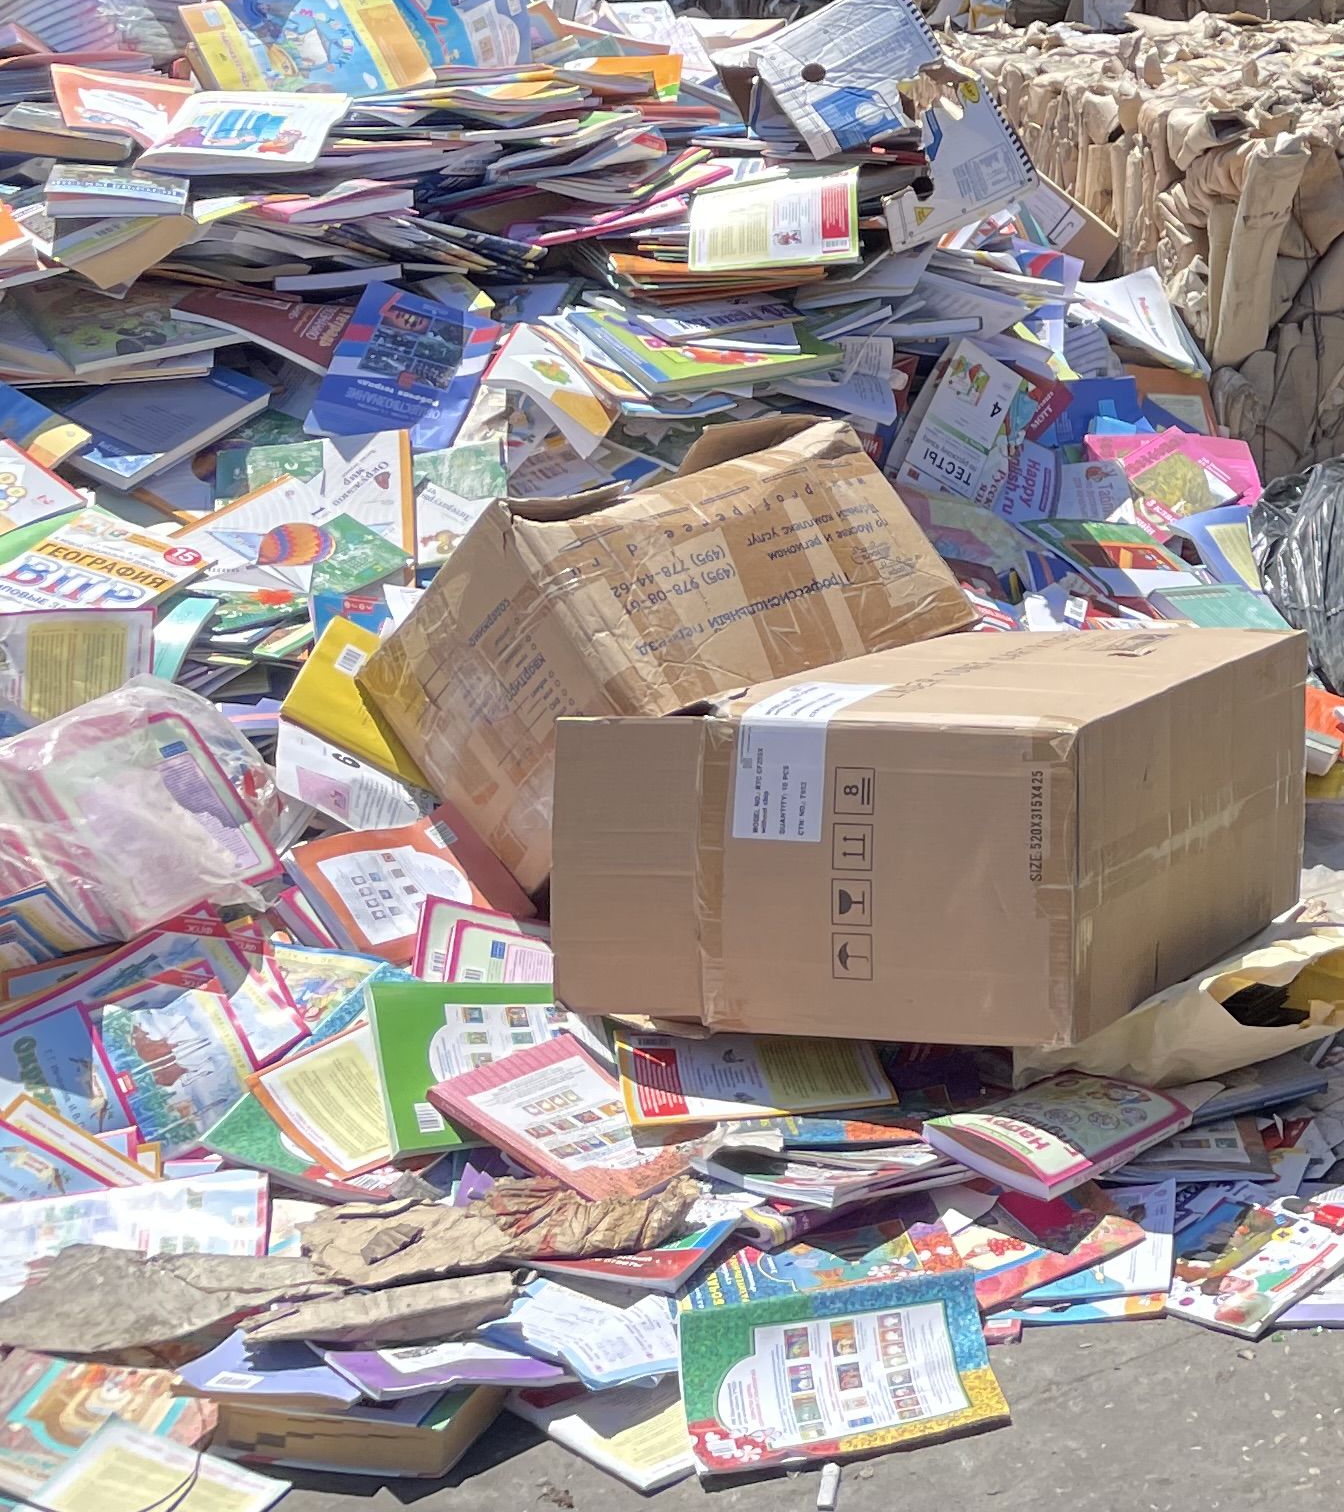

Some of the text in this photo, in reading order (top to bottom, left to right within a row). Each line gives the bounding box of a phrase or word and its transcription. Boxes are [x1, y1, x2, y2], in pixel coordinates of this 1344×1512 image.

[990, 401, 1002, 418] 4
[923, 447, 972, 486] ТЕСТЫ
[986, 469, 1006, 509] Русск
[1020, 458, 1041, 509] Happy
[782, 512, 834, 537] комплекс
[835, 522, 875, 540] Москве
[746, 527, 782, 548] услуг
[767, 536, 823, 561] регионам
[36, 542, 168, 589] ГЕОГРАФИЯ
[171, 548, 199, 562] 15
[0, 553, 147, 608] ВПР
[609, 544, 727, 599] (495) 778-44-62
[701, 562, 737, 587] (495)
[843, 783, 860, 797] 8
[981, 1116, 1051, 1151] Happy
